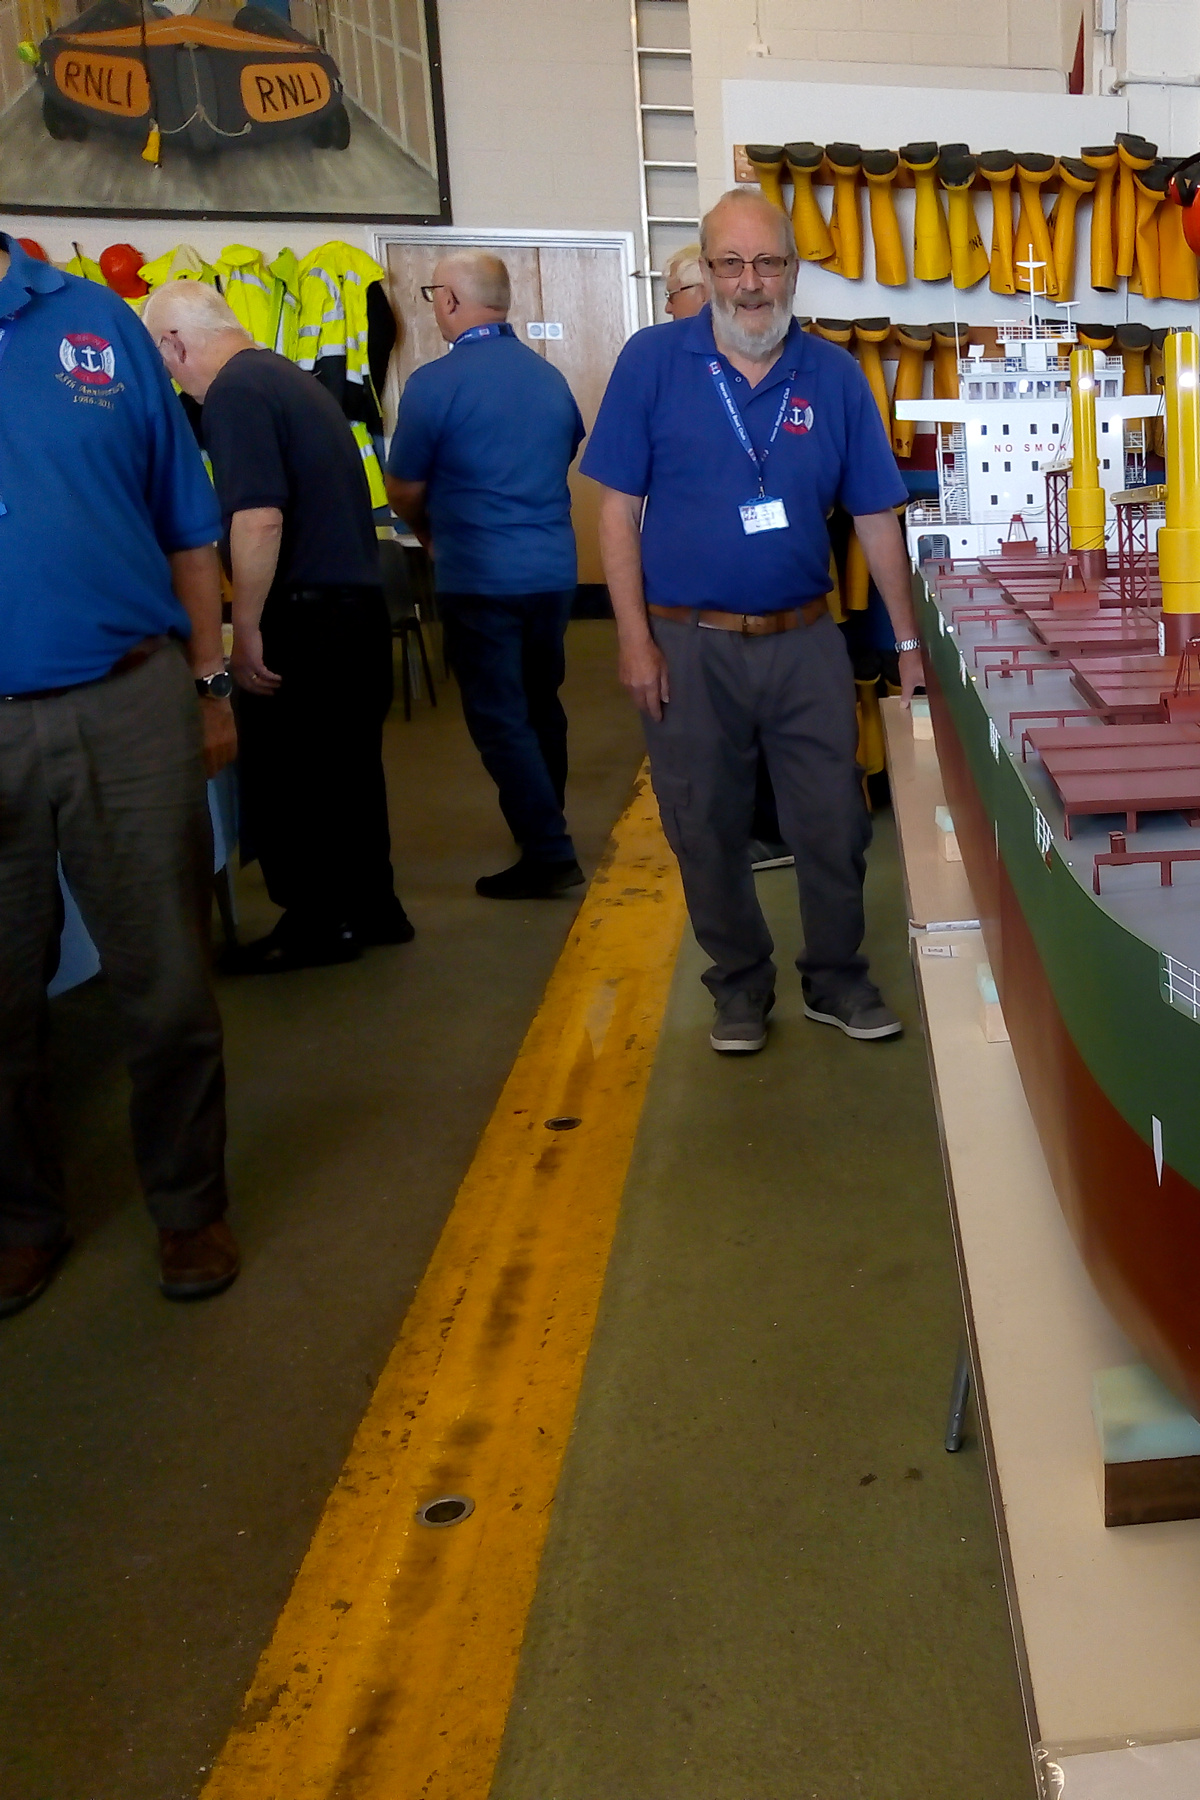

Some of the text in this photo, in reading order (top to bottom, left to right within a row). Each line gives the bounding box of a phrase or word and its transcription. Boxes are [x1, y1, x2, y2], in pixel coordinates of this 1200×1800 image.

[65, 61, 132, 108] RNLI
[255, 72, 321, 113] RNLI
[994, 443, 1067, 453] NO SMOK
